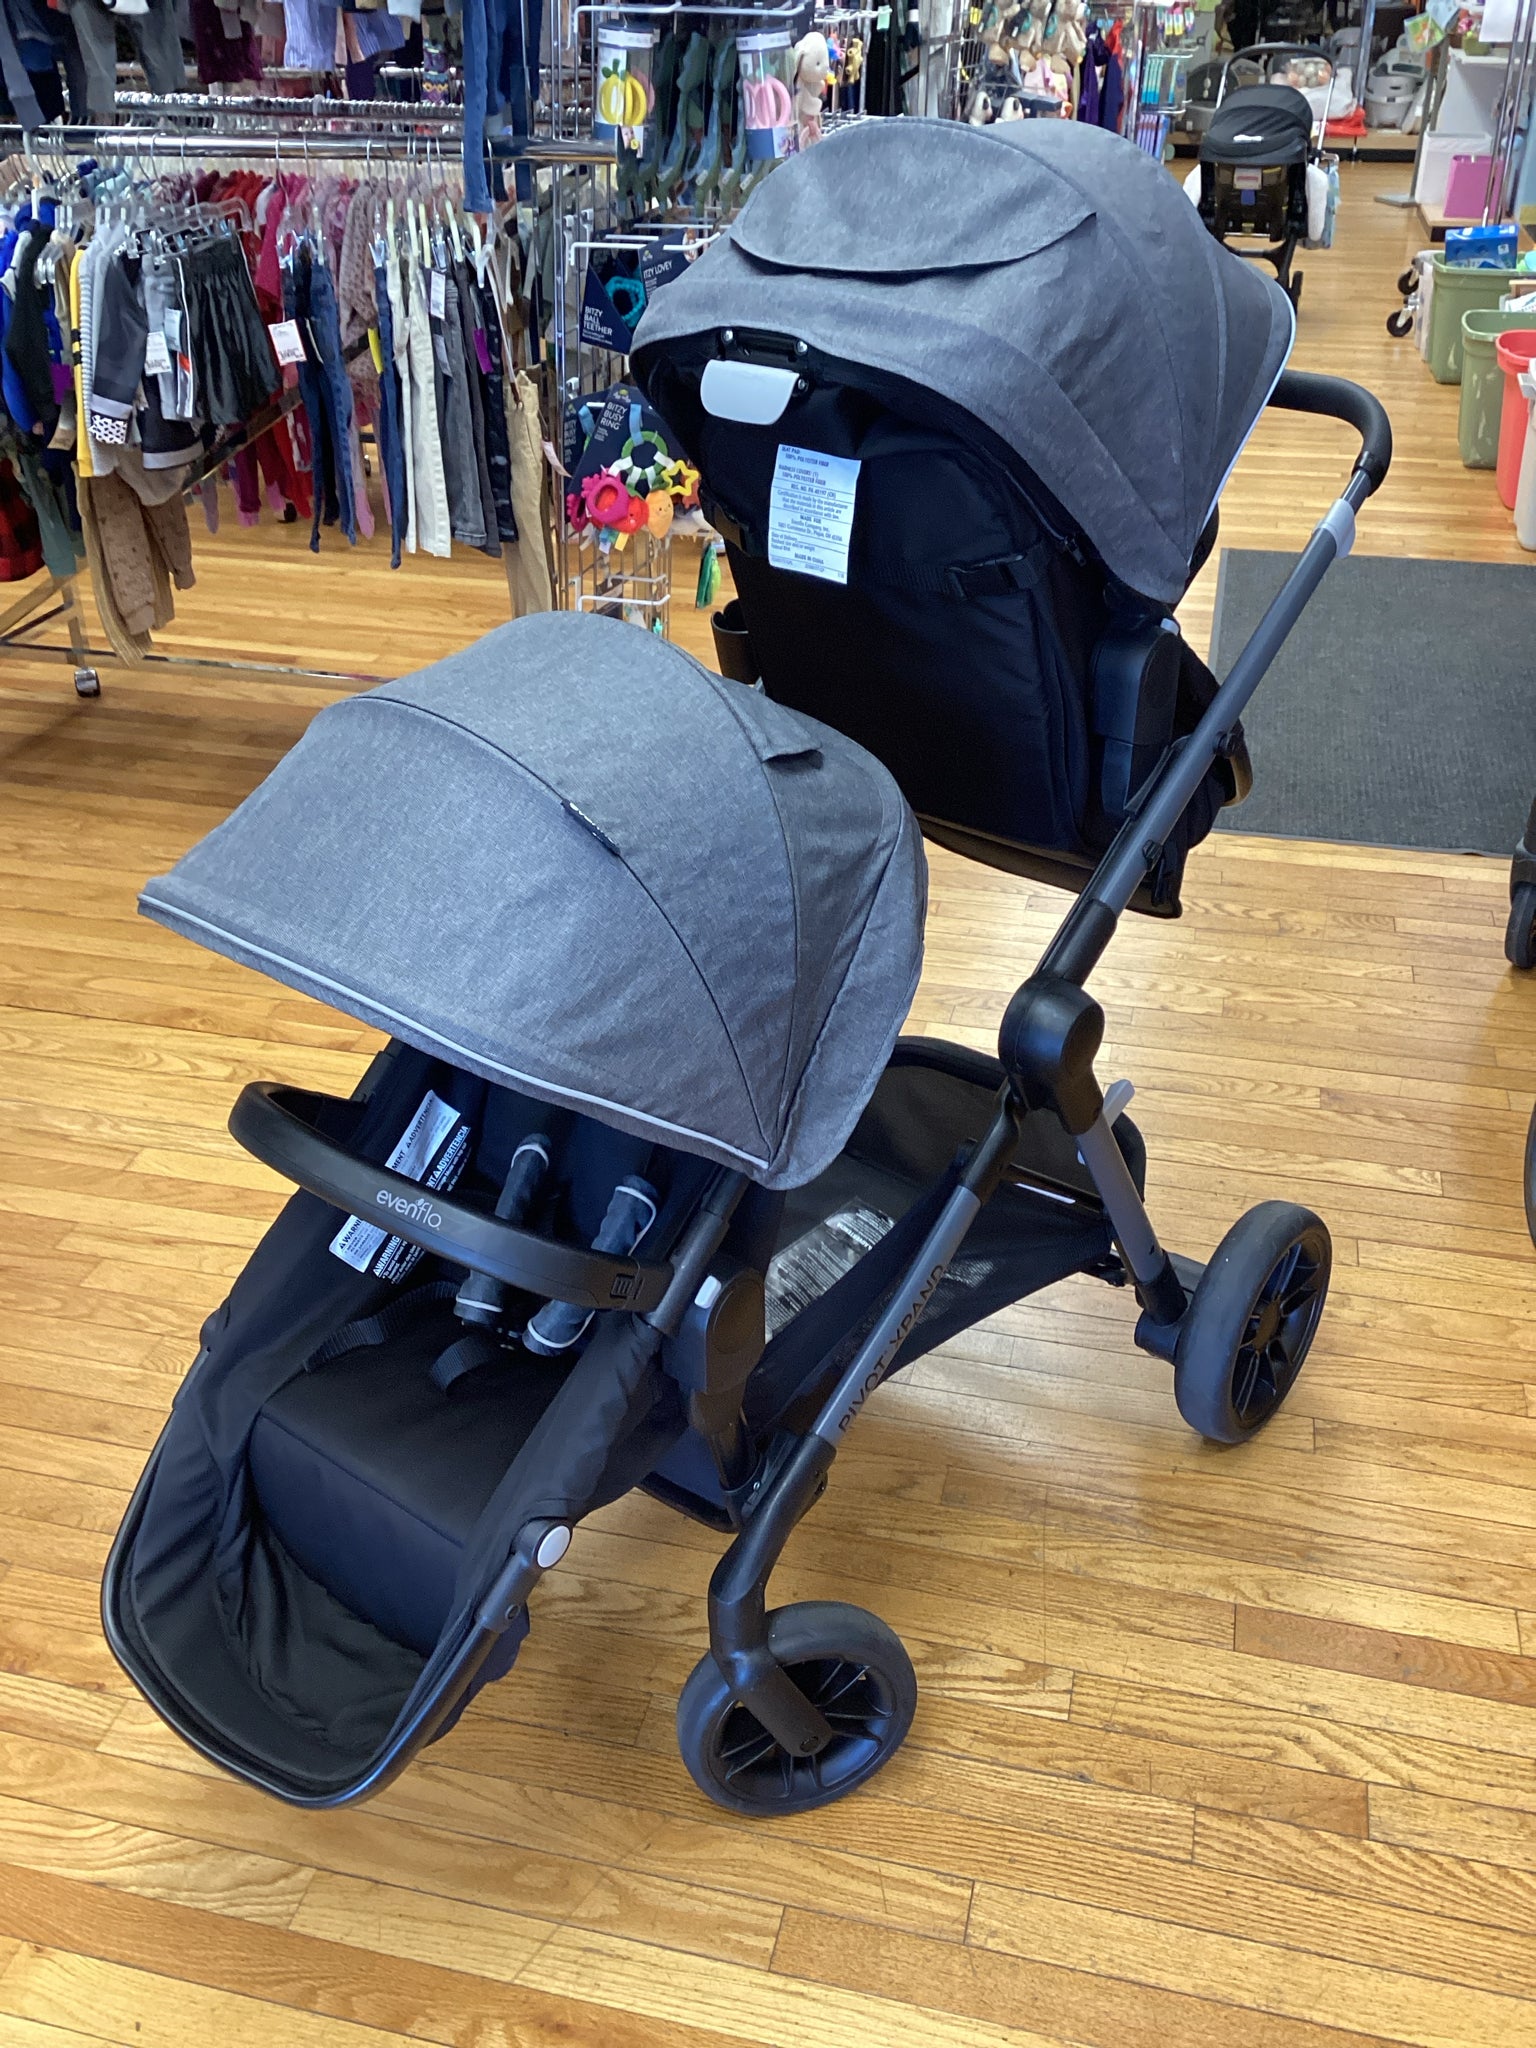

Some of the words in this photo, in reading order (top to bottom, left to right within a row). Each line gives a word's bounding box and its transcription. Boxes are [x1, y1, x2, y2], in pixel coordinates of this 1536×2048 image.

[655, 260, 673, 275] LOVEY
[584, 306, 603, 317] BITZY
[584, 314, 600, 325] BALL
[583, 322, 613, 336] TEETHER
[603, 410, 625, 422] BUSY
[607, 402, 628, 415] BITZY
[600, 417, 621, 430] RING
[408, 1098, 433, 1142] ADVERTENCIA
[436, 1125, 469, 1172] ADVERTENCIA
[376, 1189, 442, 1228] evenflo
[342, 1219, 362, 1243] WARNI
[375, 1235, 401, 1272] WARNING
[838, 1355, 885, 1432] PIVOT
[889, 1265, 944, 1348] XPAND
